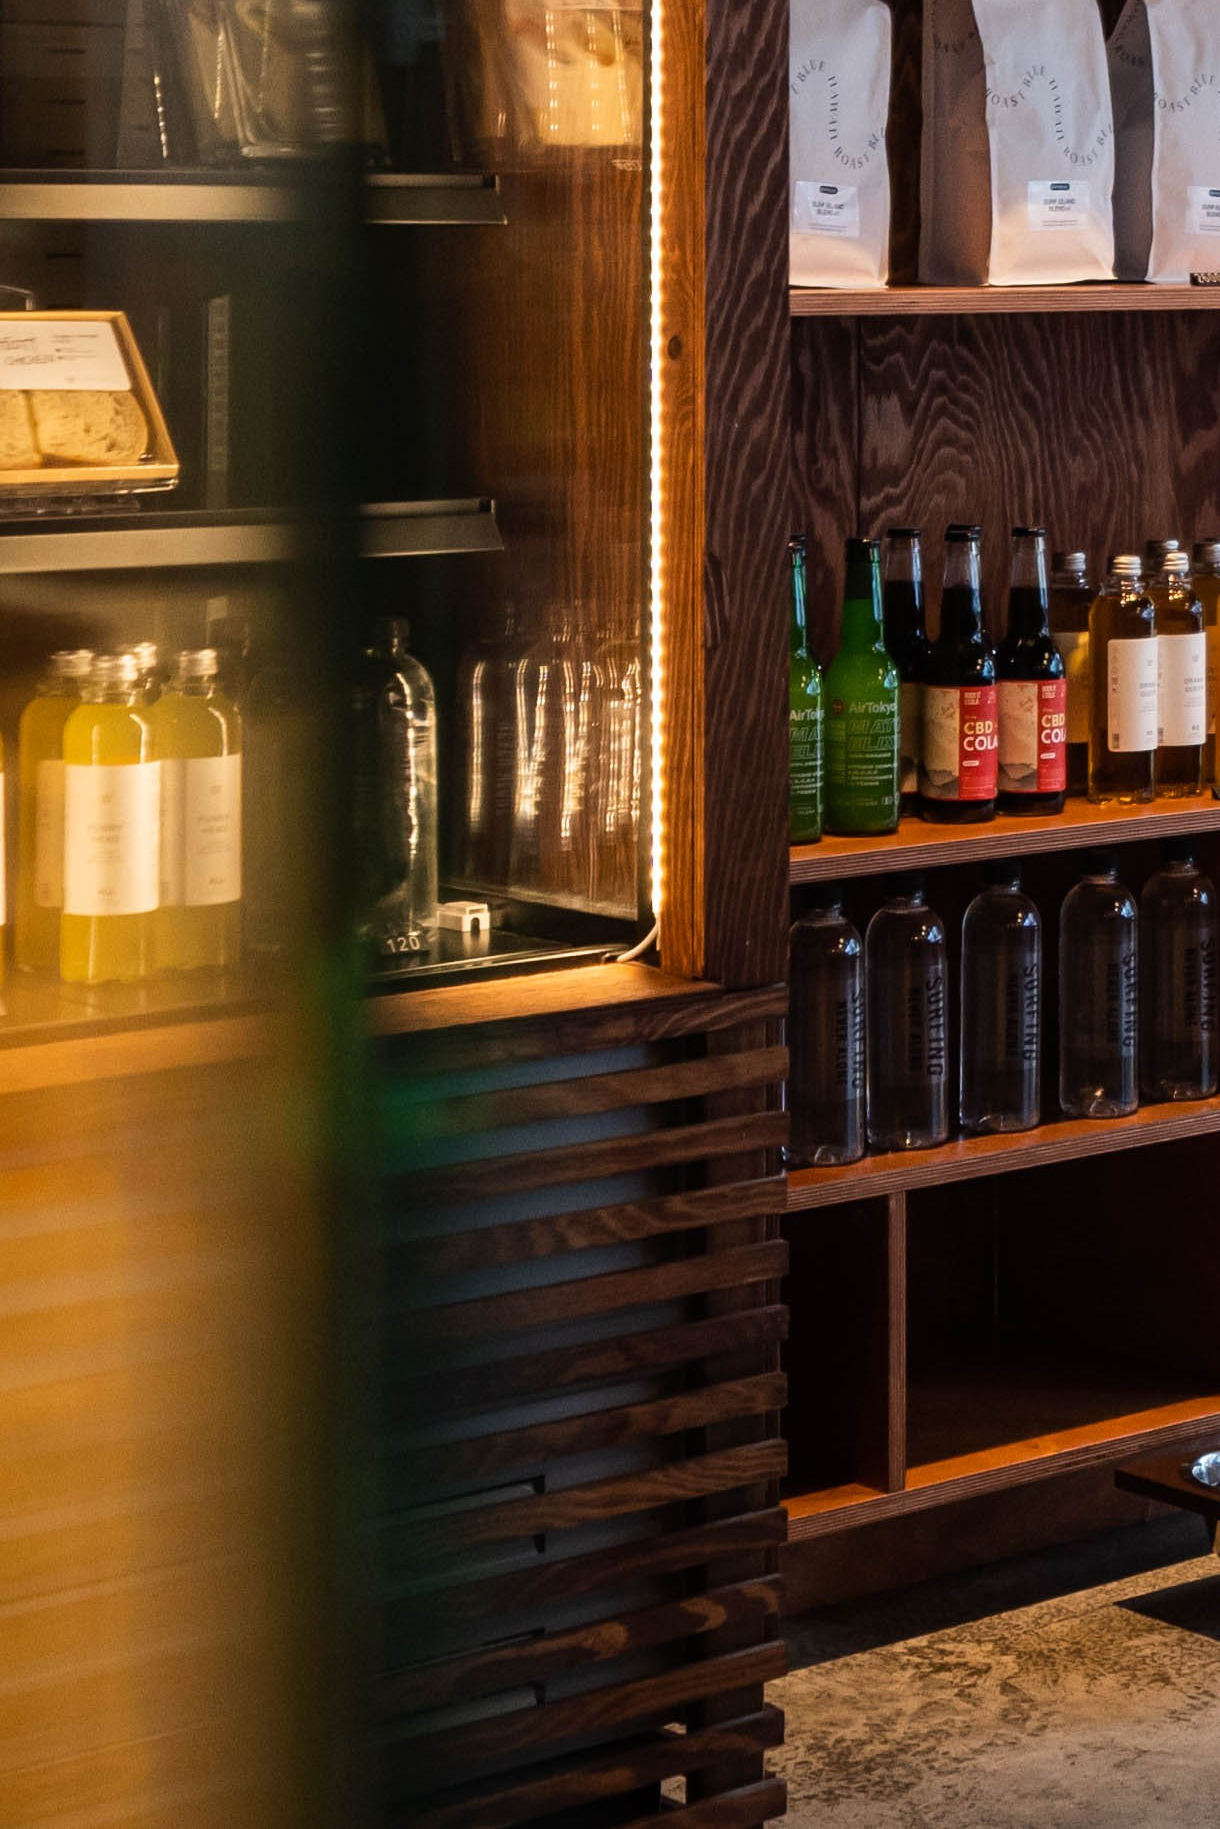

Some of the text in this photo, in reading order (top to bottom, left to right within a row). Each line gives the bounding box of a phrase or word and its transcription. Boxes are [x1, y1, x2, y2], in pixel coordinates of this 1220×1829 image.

[963, 720, 993, 735] CBD
[1041, 713, 1066, 728] CBD
[963, 734, 999, 751] COLA
[1041, 728, 1066, 744] COL
[386, 935, 420, 953] 120
[1121, 952, 1137, 1047] SURFING
[1023, 963, 1040, 1060] SURFING
[926, 976, 945, 1076] SURFING
